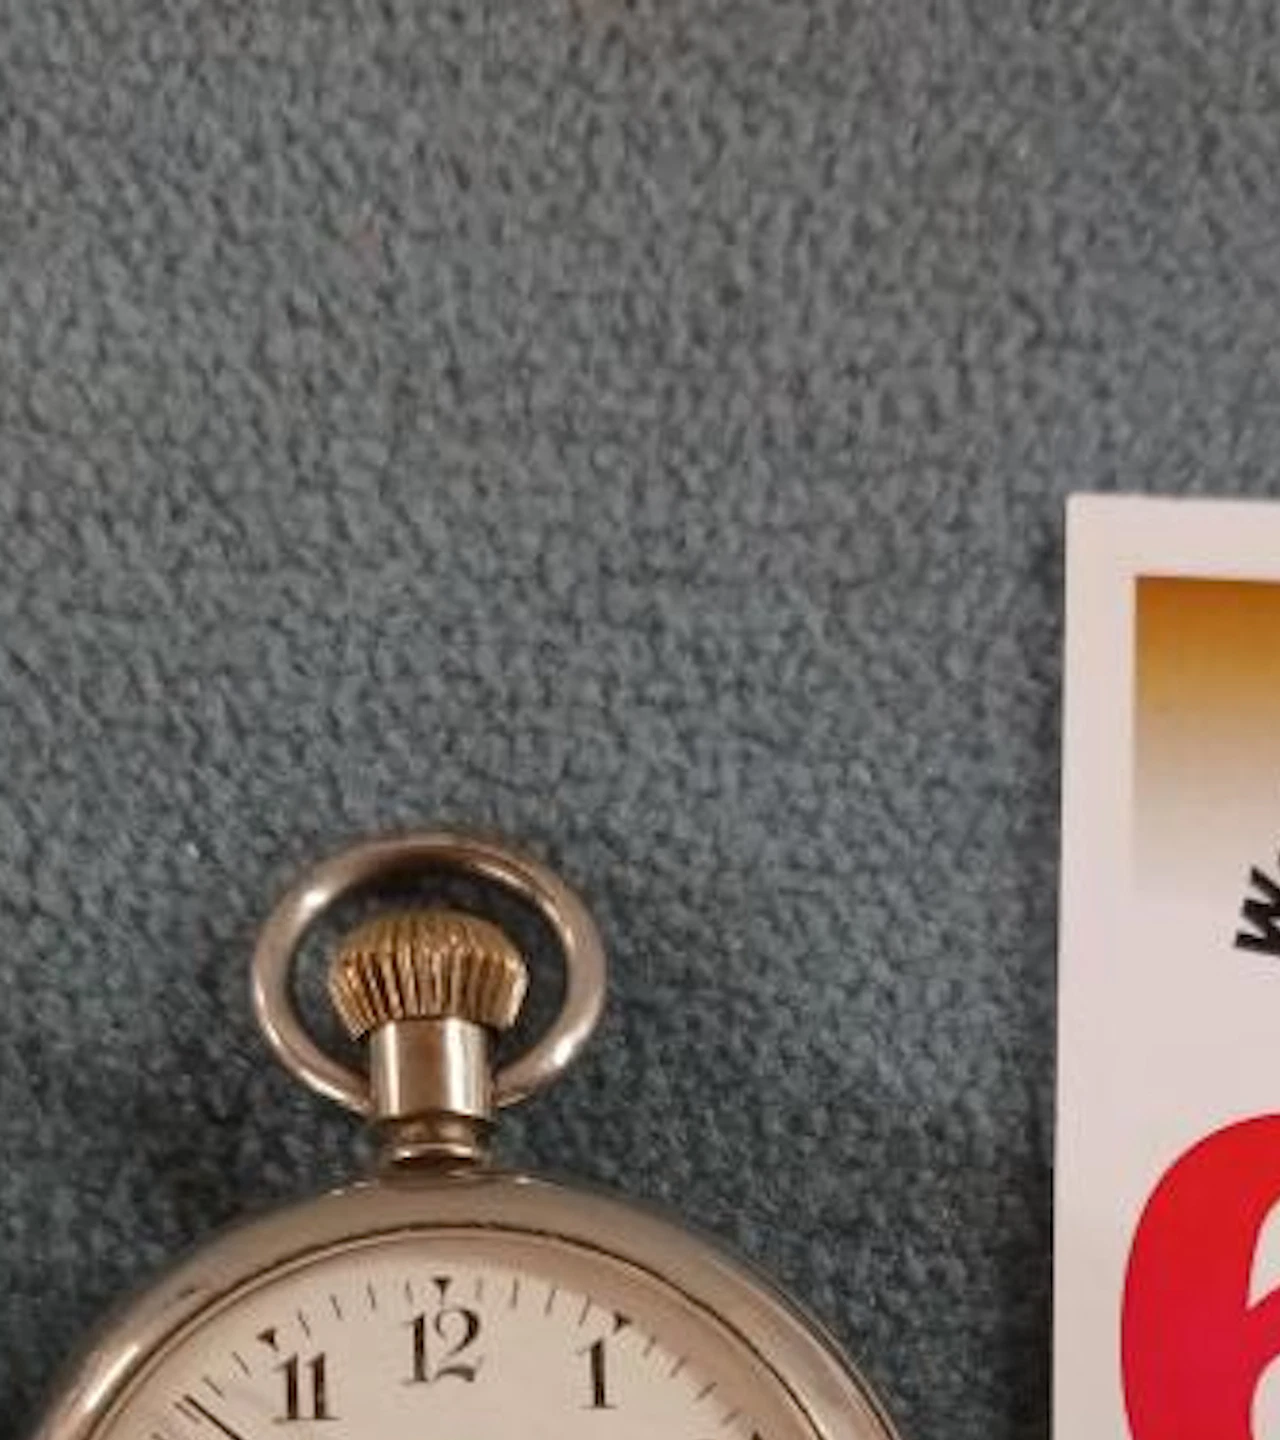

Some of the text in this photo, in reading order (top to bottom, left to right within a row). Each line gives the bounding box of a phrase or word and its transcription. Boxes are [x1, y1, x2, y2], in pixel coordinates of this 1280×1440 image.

[402, 1307, 483, 1385] 12
[578, 1337, 616, 1409] 1
[272, 1351, 340, 1424] 11
